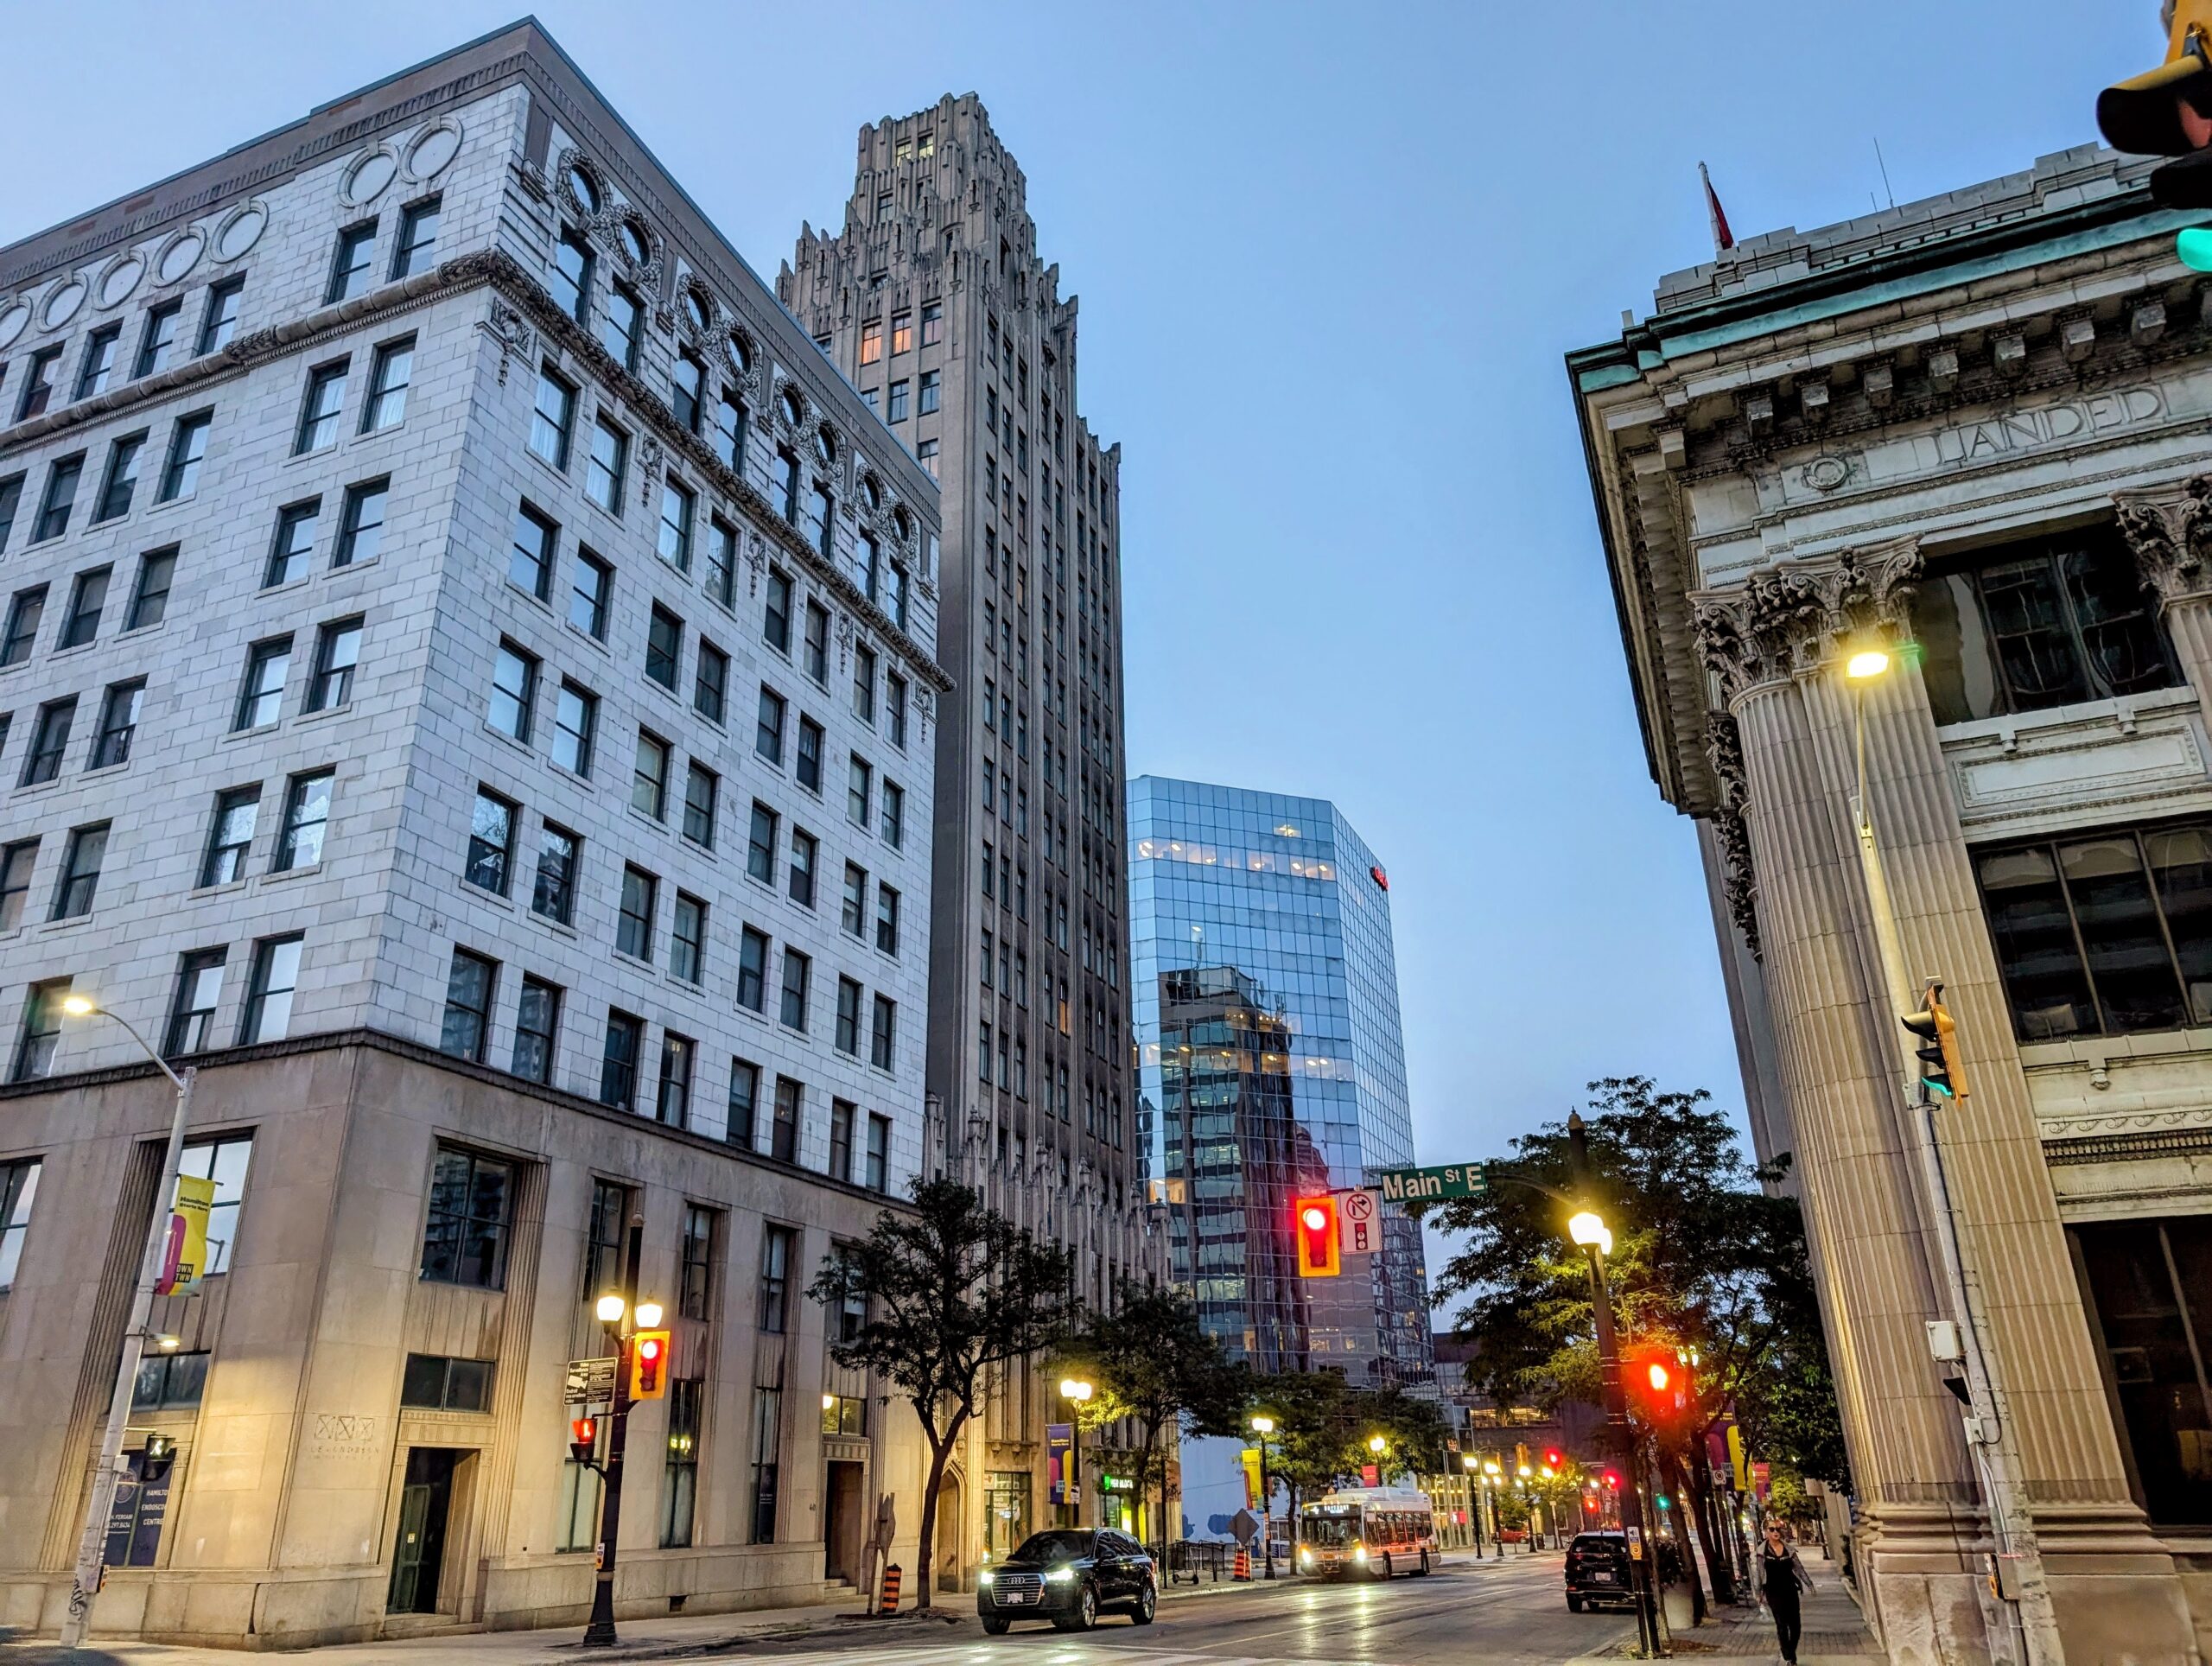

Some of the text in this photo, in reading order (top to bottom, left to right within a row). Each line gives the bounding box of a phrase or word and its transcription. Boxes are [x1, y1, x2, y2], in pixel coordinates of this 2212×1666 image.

[1929, 388, 2162, 464] LANDED
[1382, 1166, 1484, 1200] Main St E
[180, 1196, 209, 1206] Hamilton
